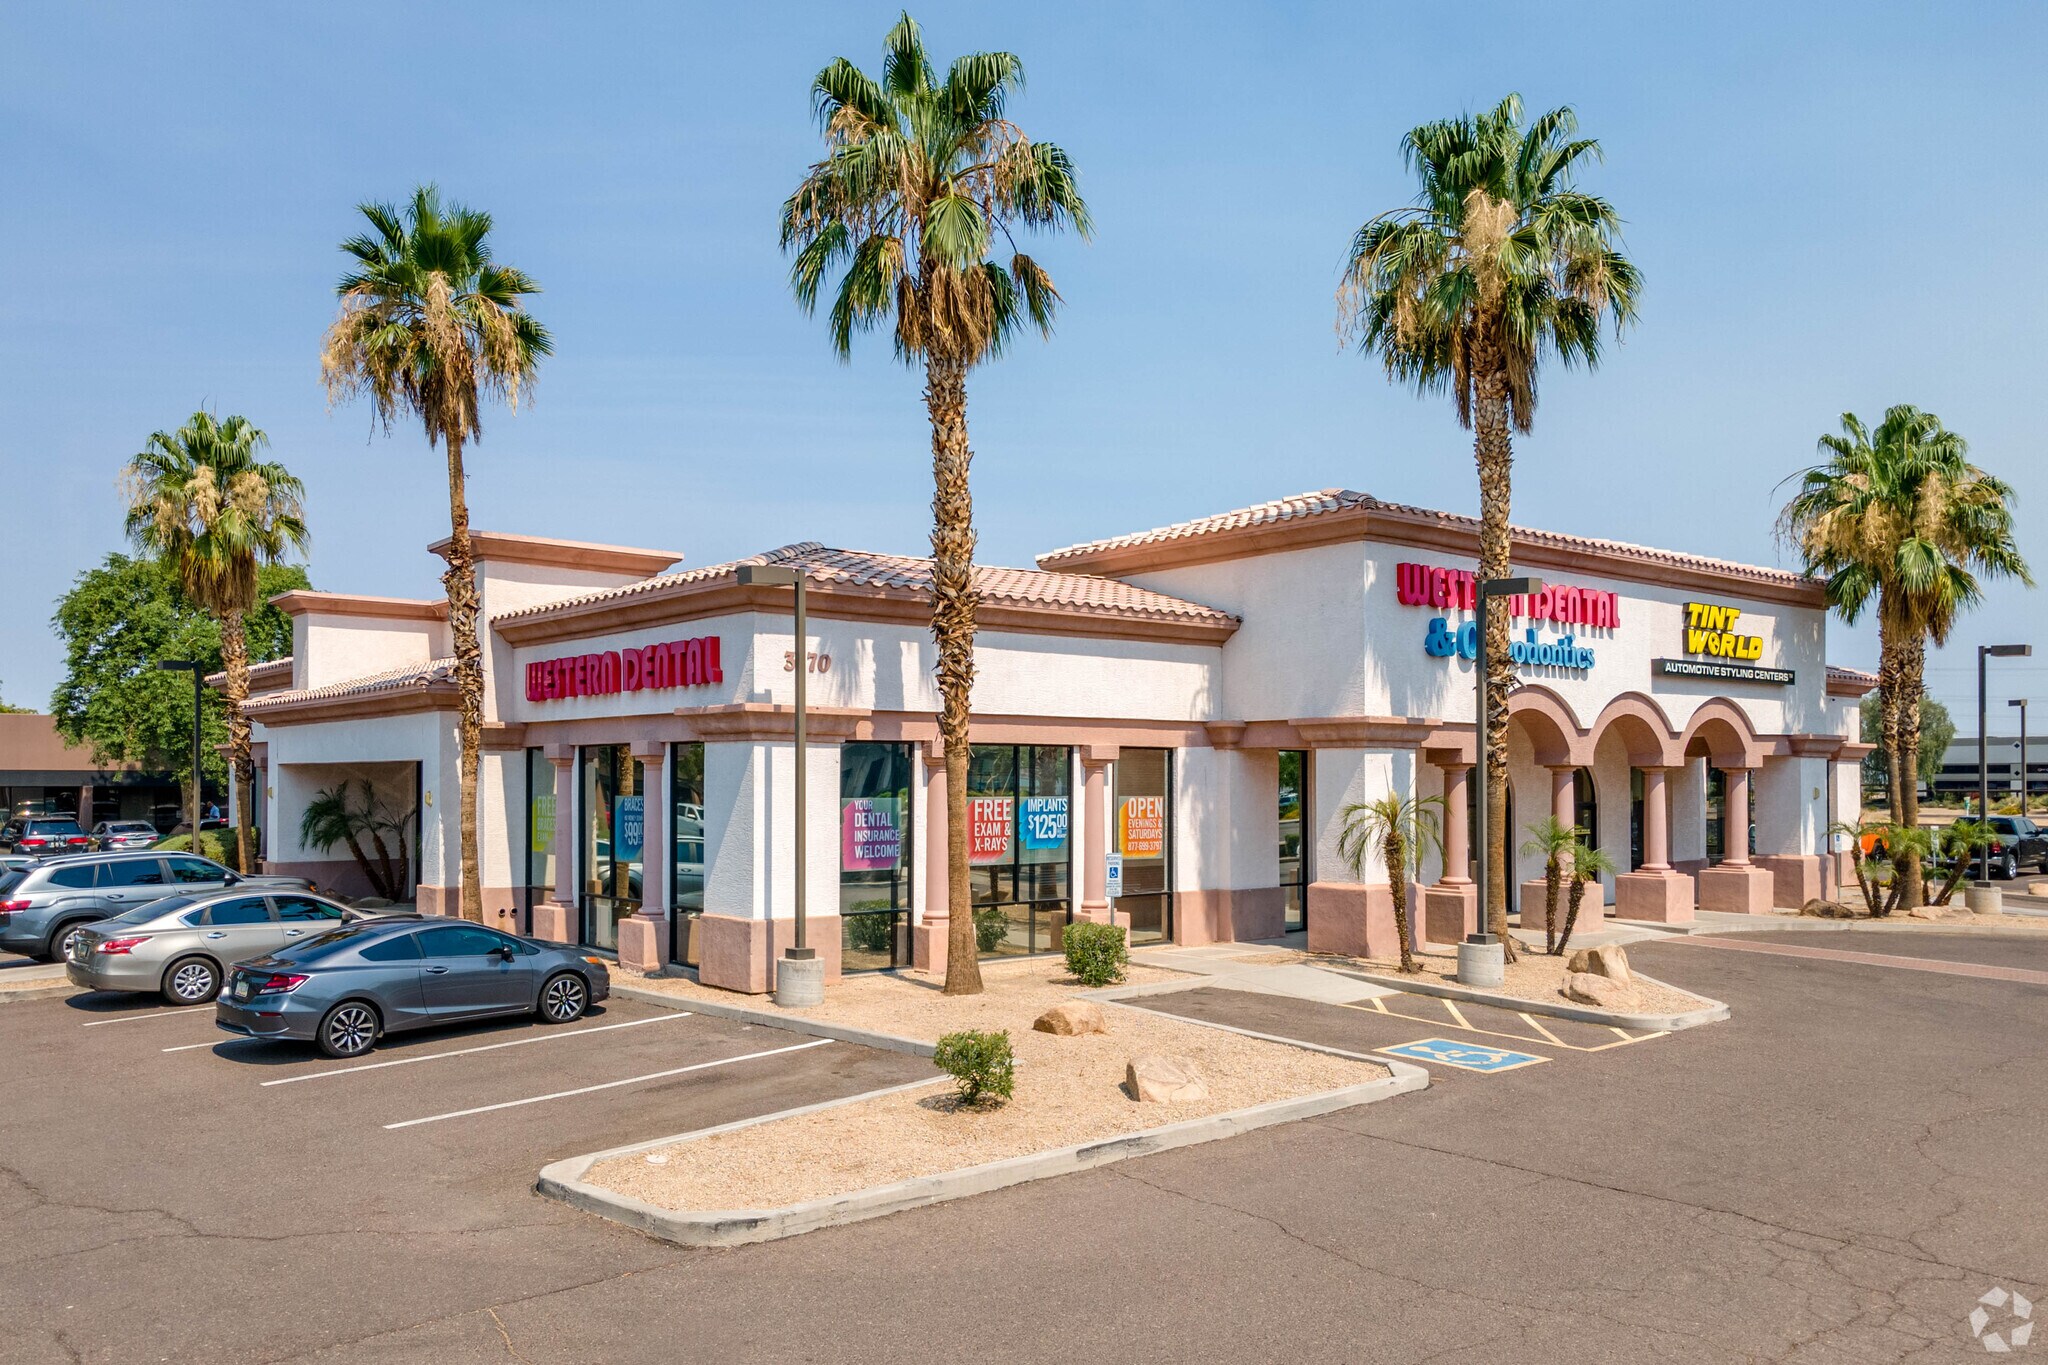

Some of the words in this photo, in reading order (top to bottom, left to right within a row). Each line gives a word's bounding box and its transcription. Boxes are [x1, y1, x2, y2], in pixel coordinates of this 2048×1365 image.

[1397, 562, 1524, 617] WESTN
[1528, 582, 1620, 628] DENTAL
[1685, 602, 1741, 631] TINT
[1425, 617, 1456, 657] &
[1457, 620, 1595, 669] Oodontics
[1685, 629, 1763, 660] WORLD
[525, 651, 621, 702] WESTERN
[622, 636, 722, 691] DENTAL
[783, 651, 831, 673] 370
[1665, 662, 1719, 676] AUTOMOTIVE
[1720, 667, 1754, 679] STYLING
[854, 799, 873, 811] YOUR
[974, 799, 1012, 821] FREE
[1027, 798, 1068, 812] IMPLANTS
[1127, 797, 1163, 818] OPEN
[854, 812, 893, 828] DENTAL
[1127, 818, 1157, 829] EVENINGS
[1158, 818, 1163, 828] &
[854, 829, 901, 842] INSURANCE
[974, 822, 1001, 837] EXAM
[1004, 821, 1012, 836] &
[1127, 828, 1163, 840] SATURDAYS
[854, 844, 901, 859] WELCOME
[974, 837, 1008, 852] X-RAYS
